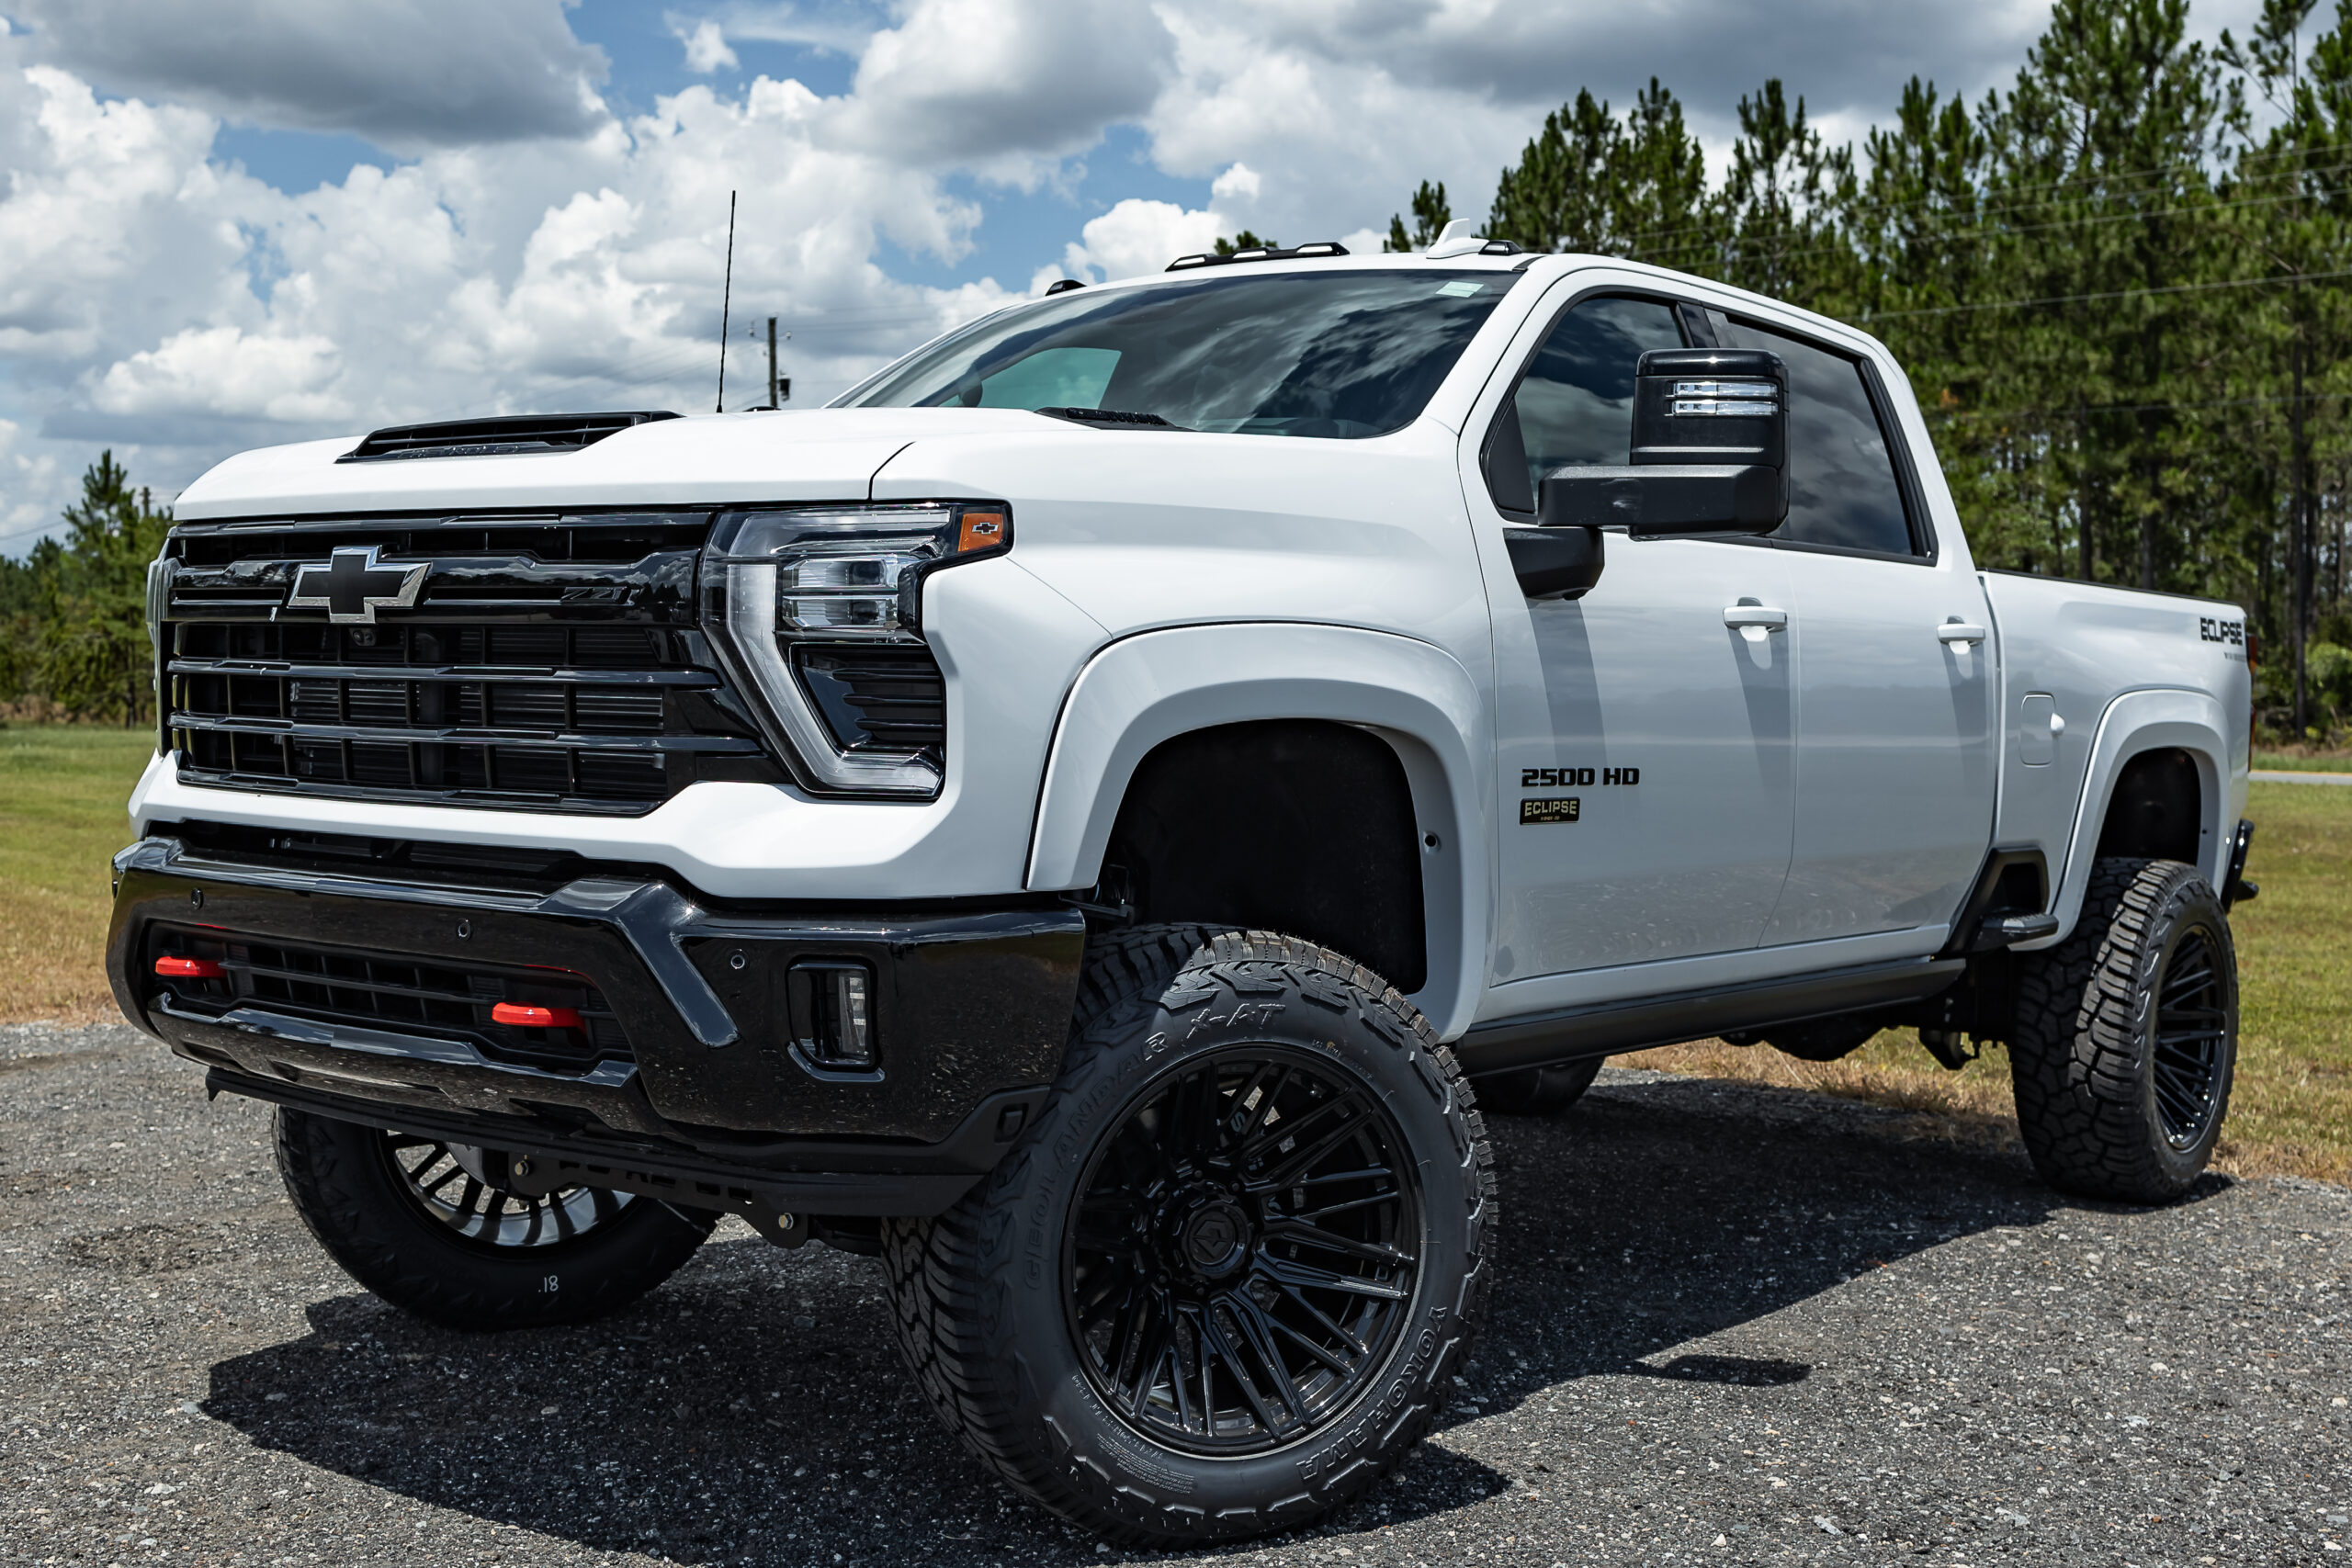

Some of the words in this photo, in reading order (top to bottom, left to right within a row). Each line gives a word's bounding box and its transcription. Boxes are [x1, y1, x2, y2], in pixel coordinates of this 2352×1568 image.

[2200, 617, 2243, 646] ECLIPSE
[1521, 768, 1596, 787] 2500
[1602, 768, 1640, 785] HD
[1524, 800, 1577, 817] ECLIPSE
[1022, 1031, 1169, 1291] GEOLANDAR
[1182, 1002, 1286, 1046] X-AT
[1295, 1304, 1449, 1481] YOKOHAMA
